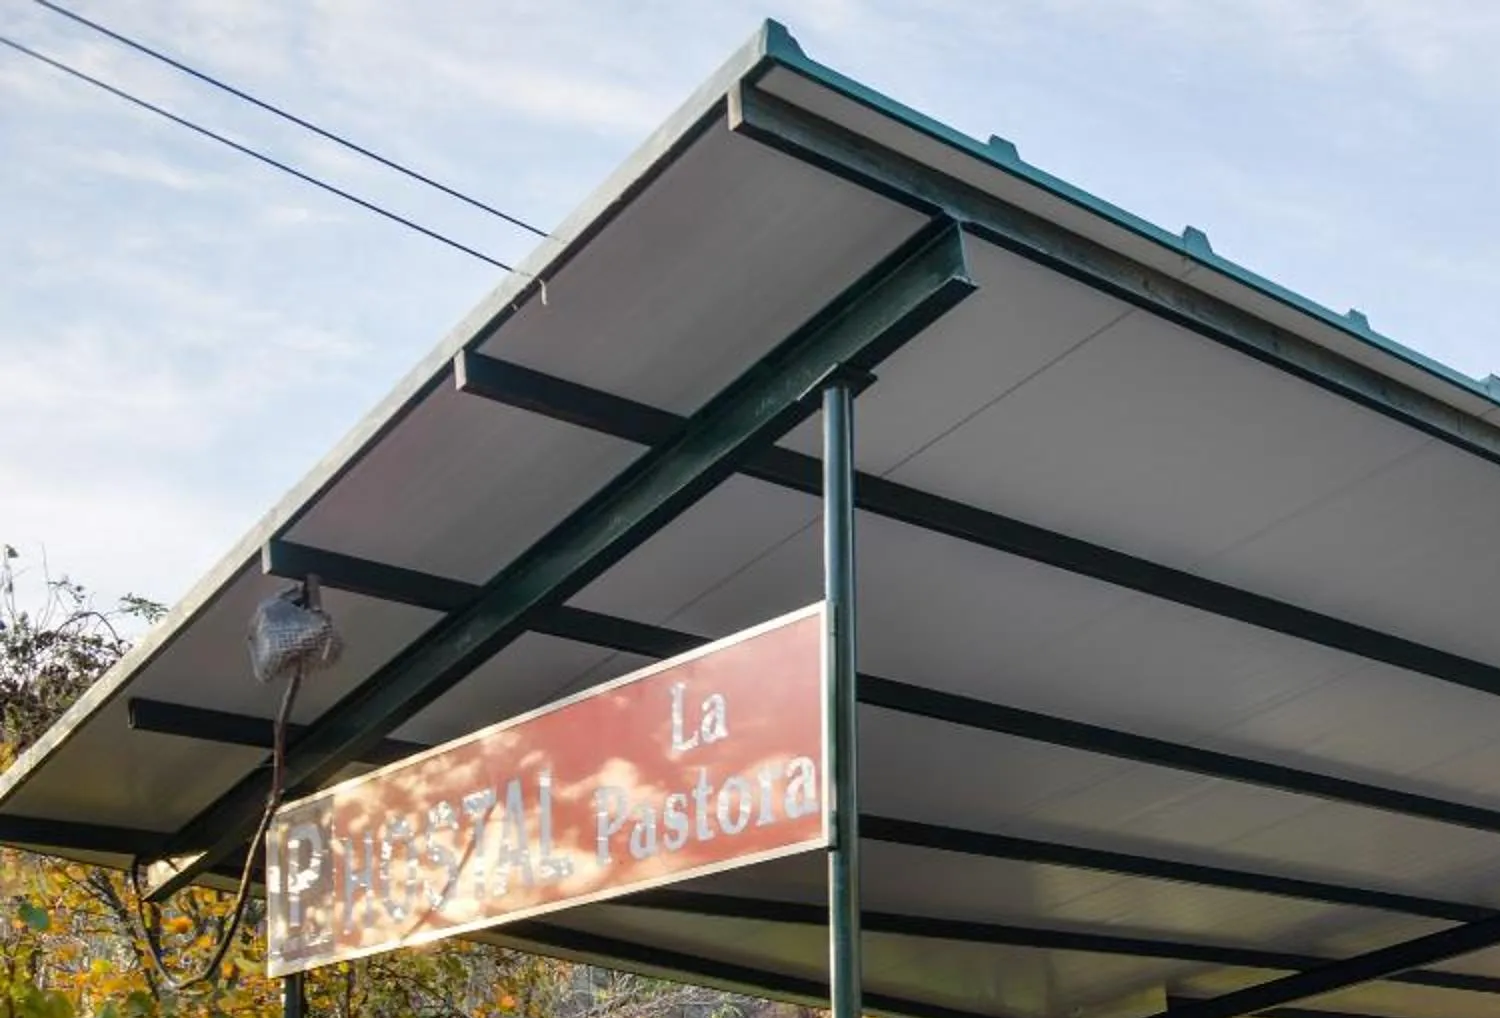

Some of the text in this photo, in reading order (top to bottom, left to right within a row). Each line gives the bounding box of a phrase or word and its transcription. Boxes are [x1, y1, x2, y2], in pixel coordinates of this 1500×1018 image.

[668, 681, 728, 753] La
[340, 769, 576, 936] HOSTAL
[593, 755, 819, 866] Pastora
